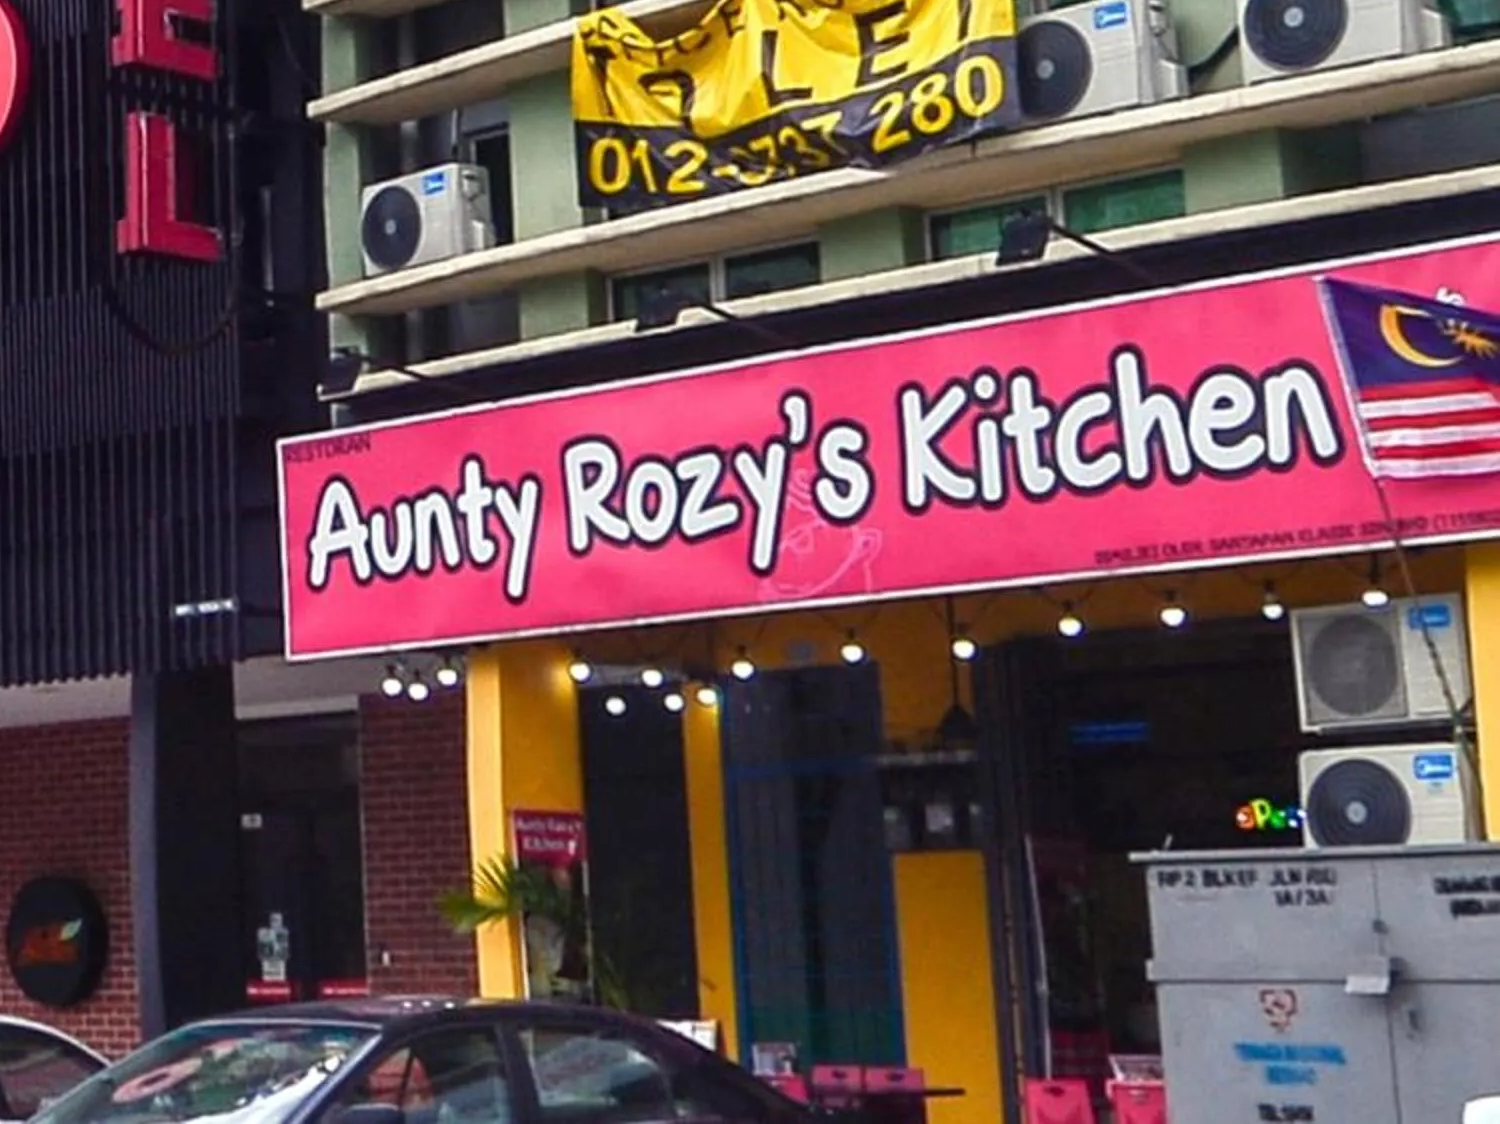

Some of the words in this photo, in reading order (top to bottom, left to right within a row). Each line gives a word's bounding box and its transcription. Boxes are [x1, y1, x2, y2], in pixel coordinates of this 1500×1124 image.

[870, 54, 1005, 153] 280
[306, 453, 542, 601] Aunty
[560, 389, 874, 575] Rozy's
[897, 342, 1344, 518] Kitchen
